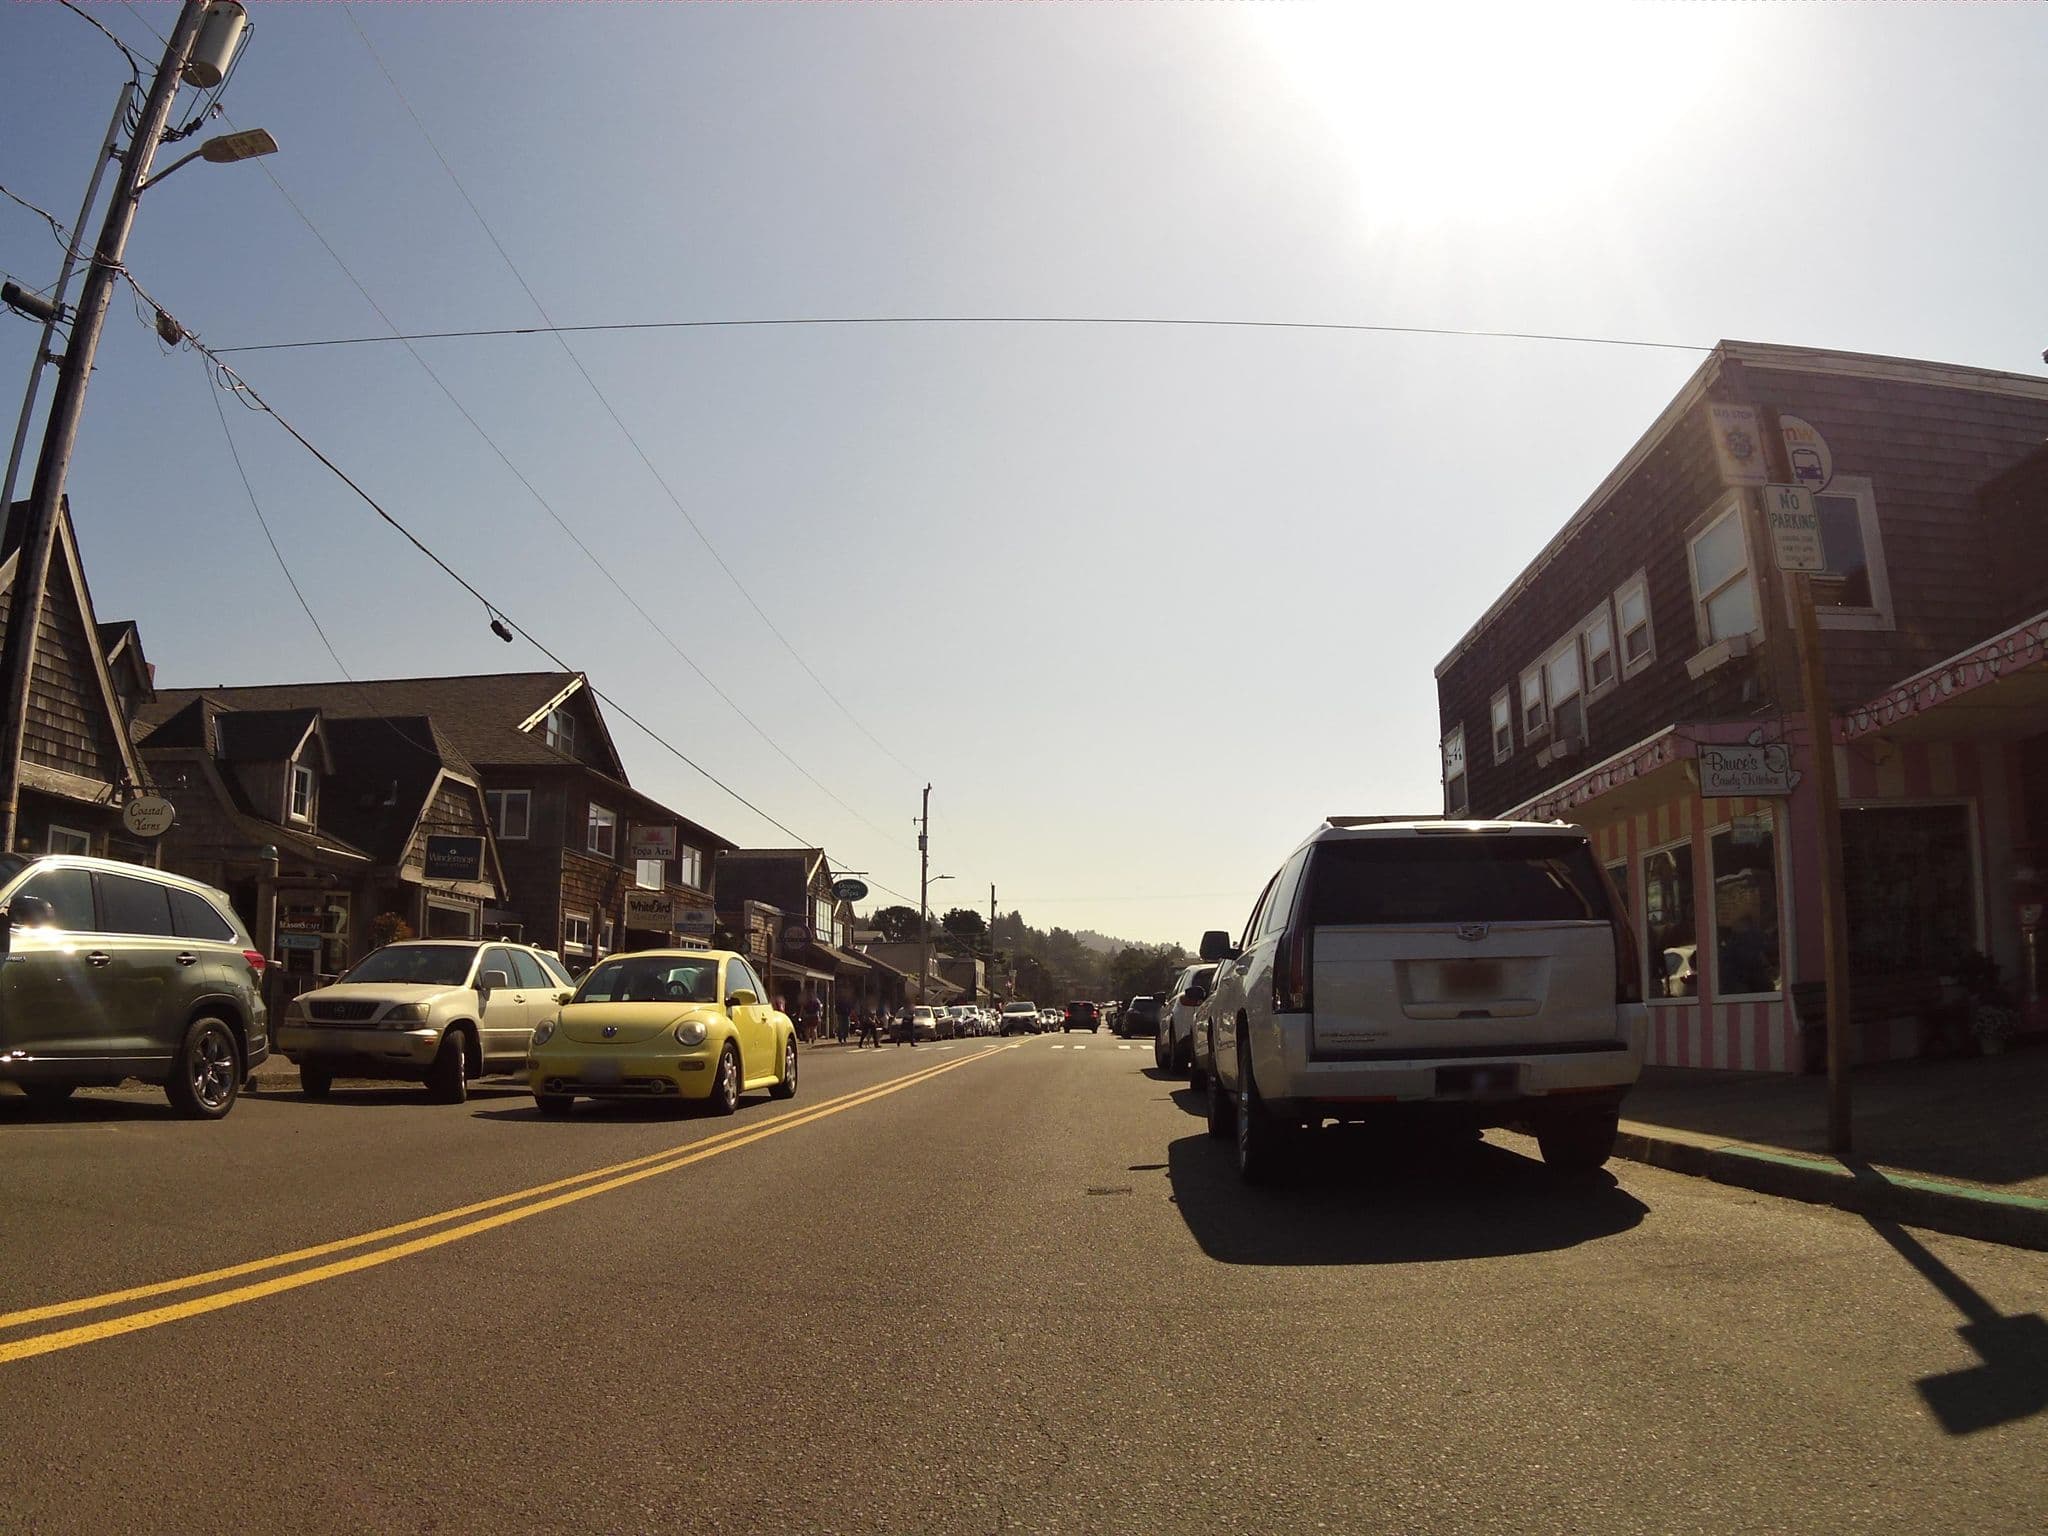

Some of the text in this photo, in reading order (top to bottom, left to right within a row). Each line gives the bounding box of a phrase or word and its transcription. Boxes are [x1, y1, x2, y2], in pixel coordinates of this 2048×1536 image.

[1779, 494, 1800, 510] NO
[1771, 512, 1817, 528] PARKING
[1704, 752, 1758, 771] Bruce's
[130, 803, 166, 816] Coastal
[134, 818, 161, 831] Yarns
